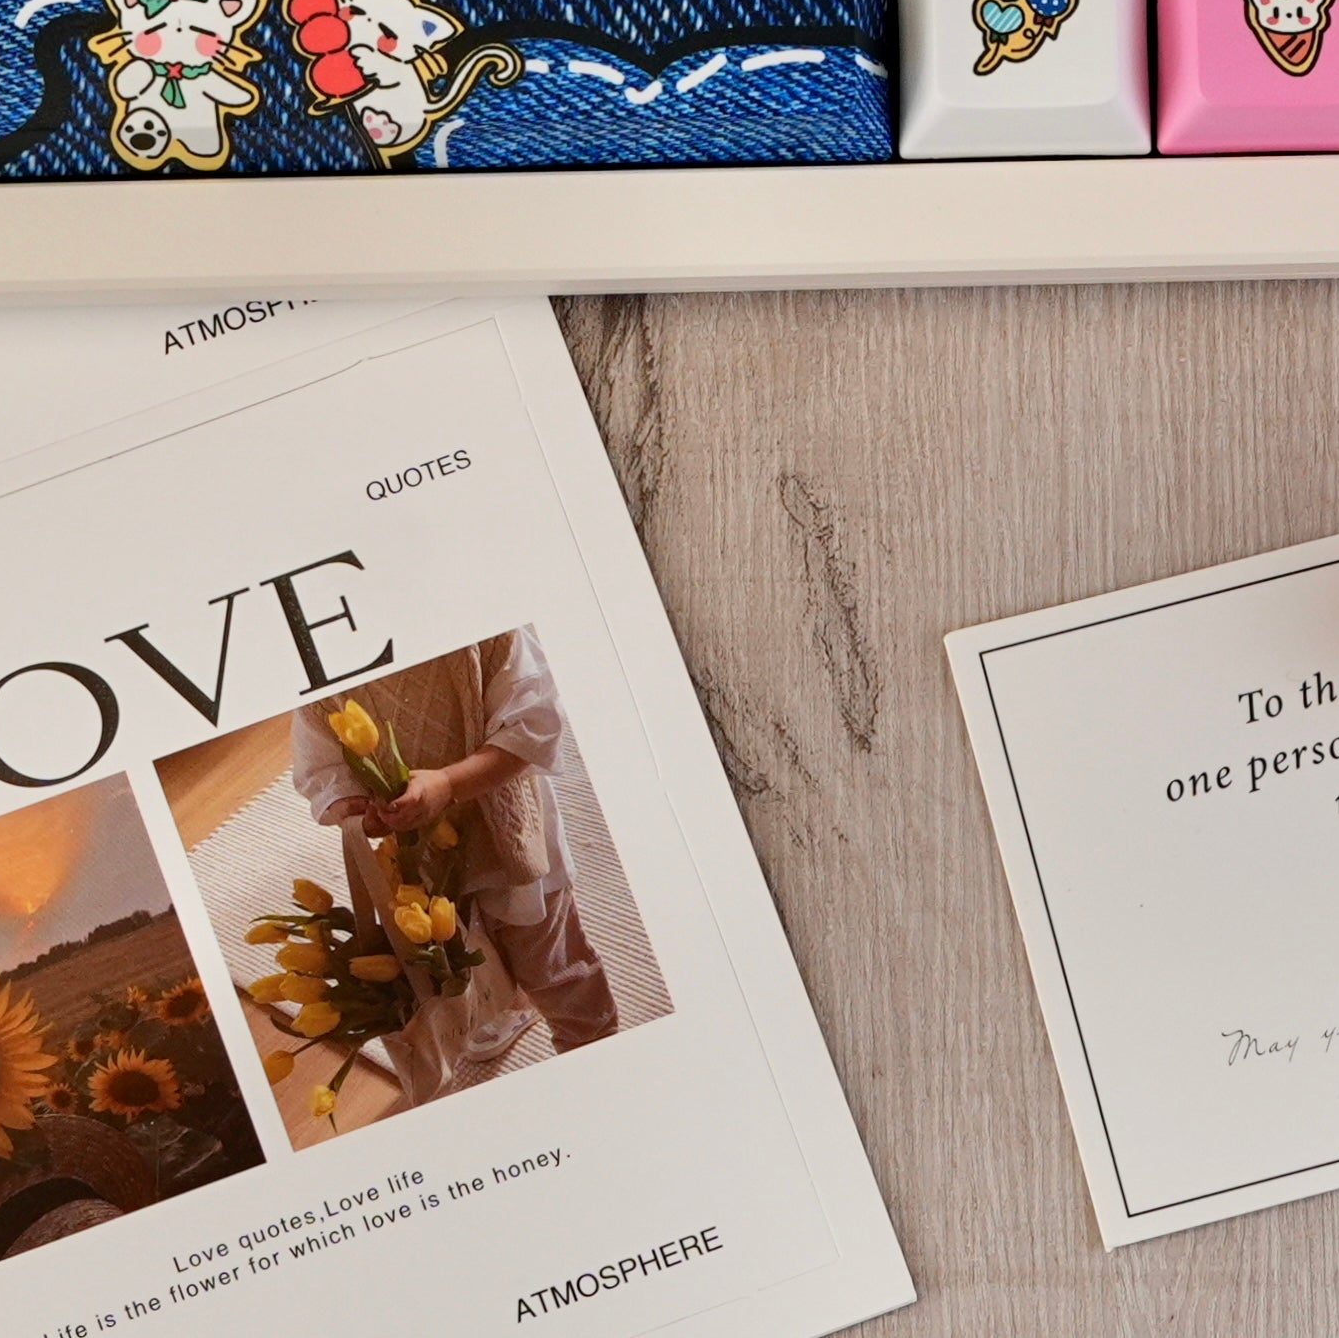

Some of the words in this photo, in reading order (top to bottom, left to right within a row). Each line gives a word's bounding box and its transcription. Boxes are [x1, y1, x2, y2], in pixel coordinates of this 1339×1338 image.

[365, 449, 473, 502] QUOTES
[1238, 688, 1283, 724] To
[1165, 765, 1233, 803] one
[1221, 1029, 1300, 1066] May
[96, 1314, 116, 1331] is
[124, 1297, 162, 1320] the
[169, 1265, 240, 1303] flower
[248, 1251, 280, 1274] for
[289, 1222, 357, 1259] which
[363, 1202, 413, 1231] love
[420, 1192, 440, 1211] is
[447, 1174, 485, 1200] the
[492, 1147, 571, 1184] honey.
[173, 1241, 229, 1273] Love
[387, 1169, 425, 1194] life
[516, 1226, 724, 1324] ATMOSPHERE
